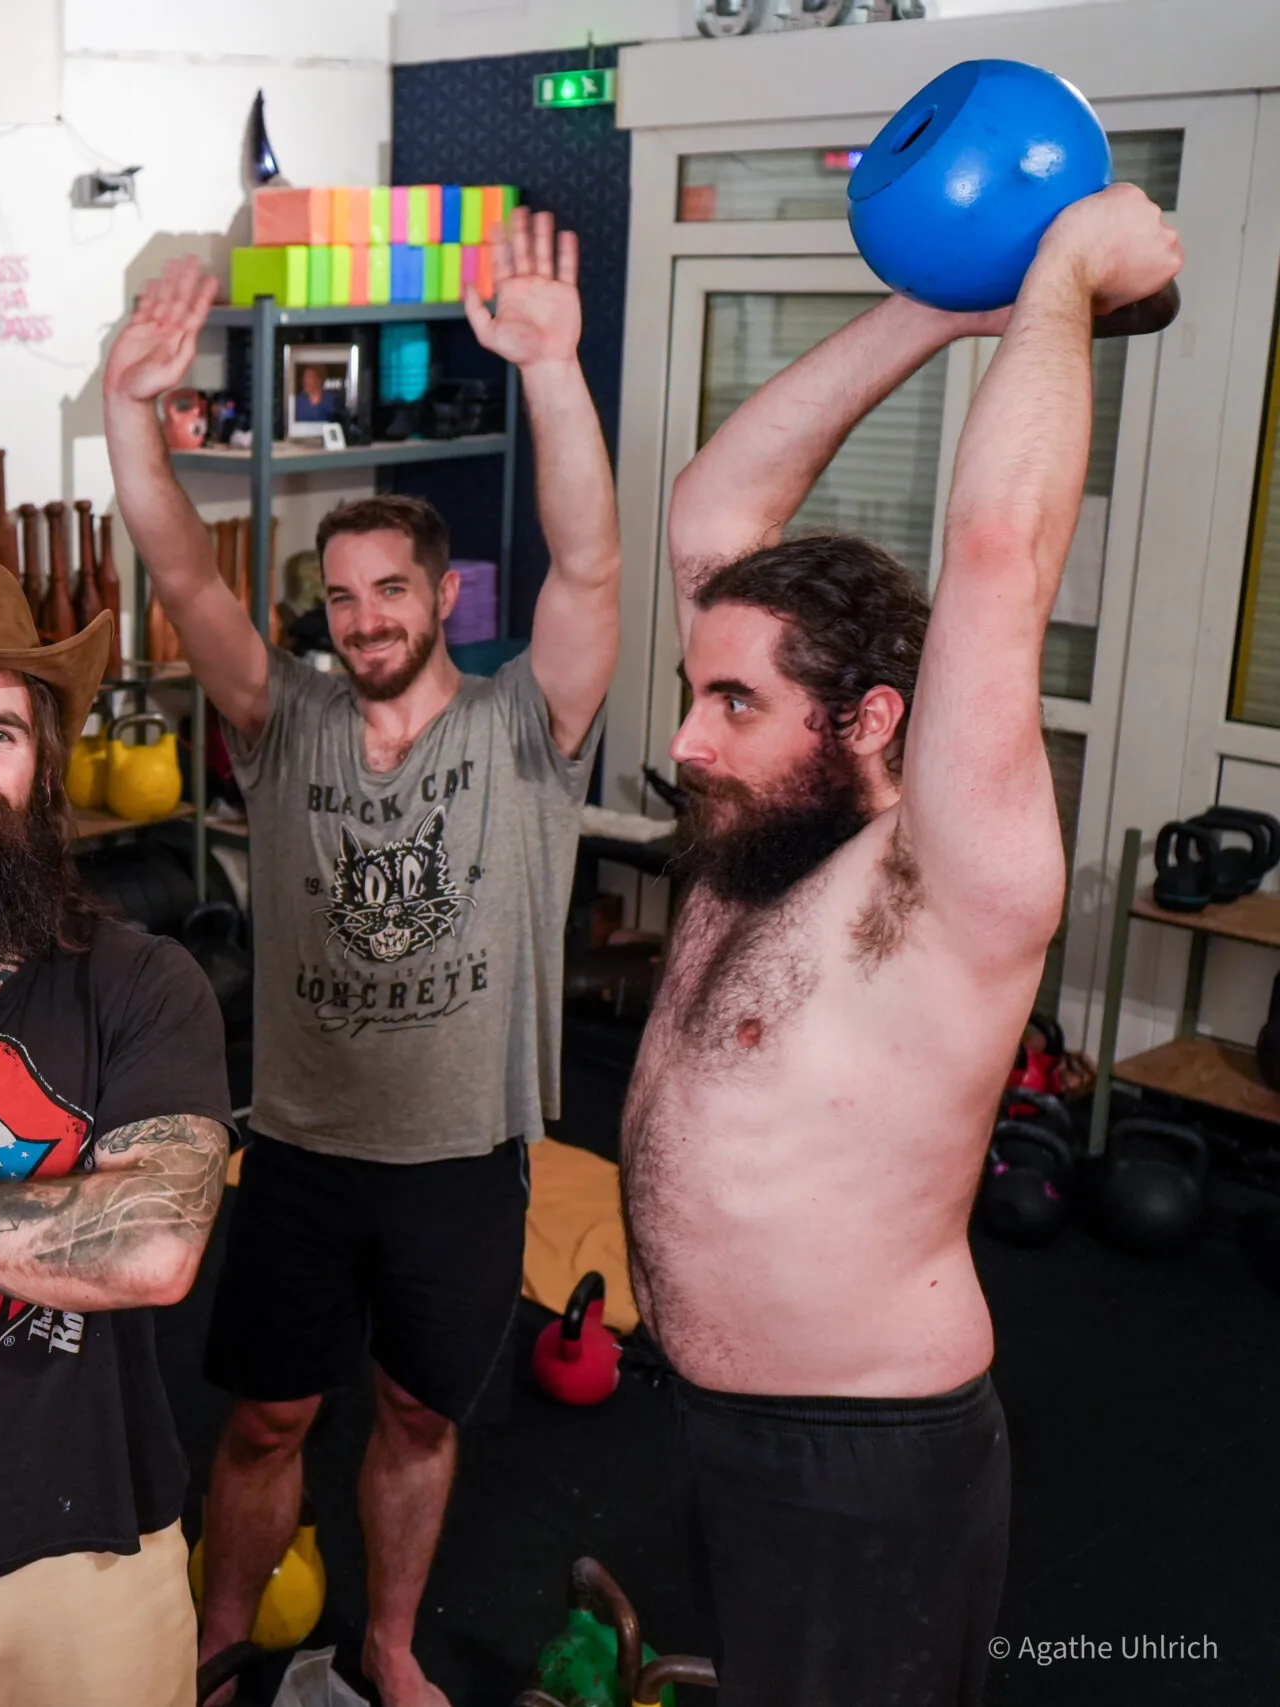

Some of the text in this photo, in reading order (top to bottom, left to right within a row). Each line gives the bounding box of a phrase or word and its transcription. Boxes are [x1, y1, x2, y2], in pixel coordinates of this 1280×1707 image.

[307, 760, 475, 826] BLACK CAT
[296, 961, 489, 1010] CONCRETE
[27, 1307, 54, 1340] The
